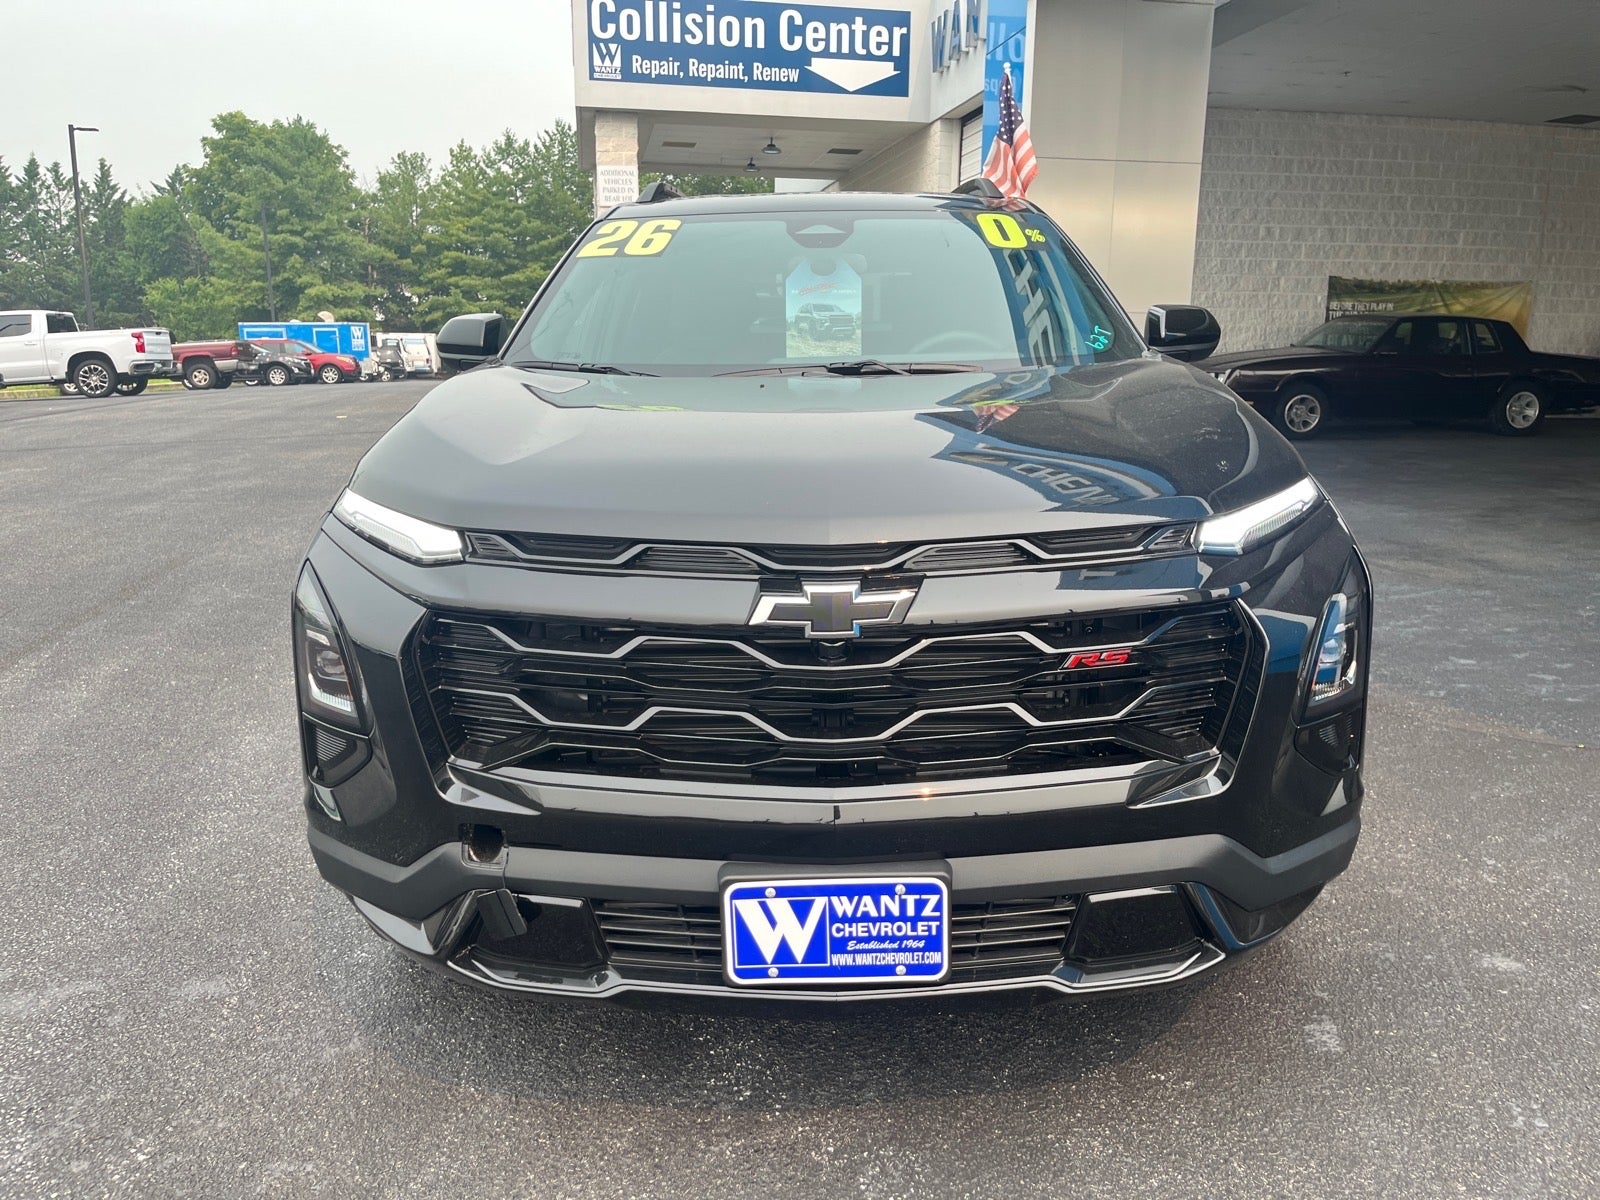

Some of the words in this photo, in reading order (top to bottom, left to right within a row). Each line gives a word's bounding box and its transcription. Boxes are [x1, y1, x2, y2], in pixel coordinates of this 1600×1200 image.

[590, 0, 765, 49] Collision
[779, 9, 908, 57] Center
[631, 55, 684, 78] Repair,
[688, 59, 749, 83] Repaint,
[753, 62, 800, 83] Renew
[599, 169, 636, 177] ADDITIONAL
[602, 186, 626, 194] PARKED
[576, 219, 682, 258] 26
[1329, 302, 1354, 311] BEFORE
[1355, 302, 1370, 311] THEY
[1370, 302, 1387, 311] PLAY
[1060, 647, 1132, 669] RS
[830, 895, 941, 918] WANTZ
[831, 921, 940, 938] CHEVROLET
[847, 940, 899, 951] Established
[901, 939, 926, 950] 1964
[831, 952, 942, 966] WWW.WANTZCHEVROLET.COM
